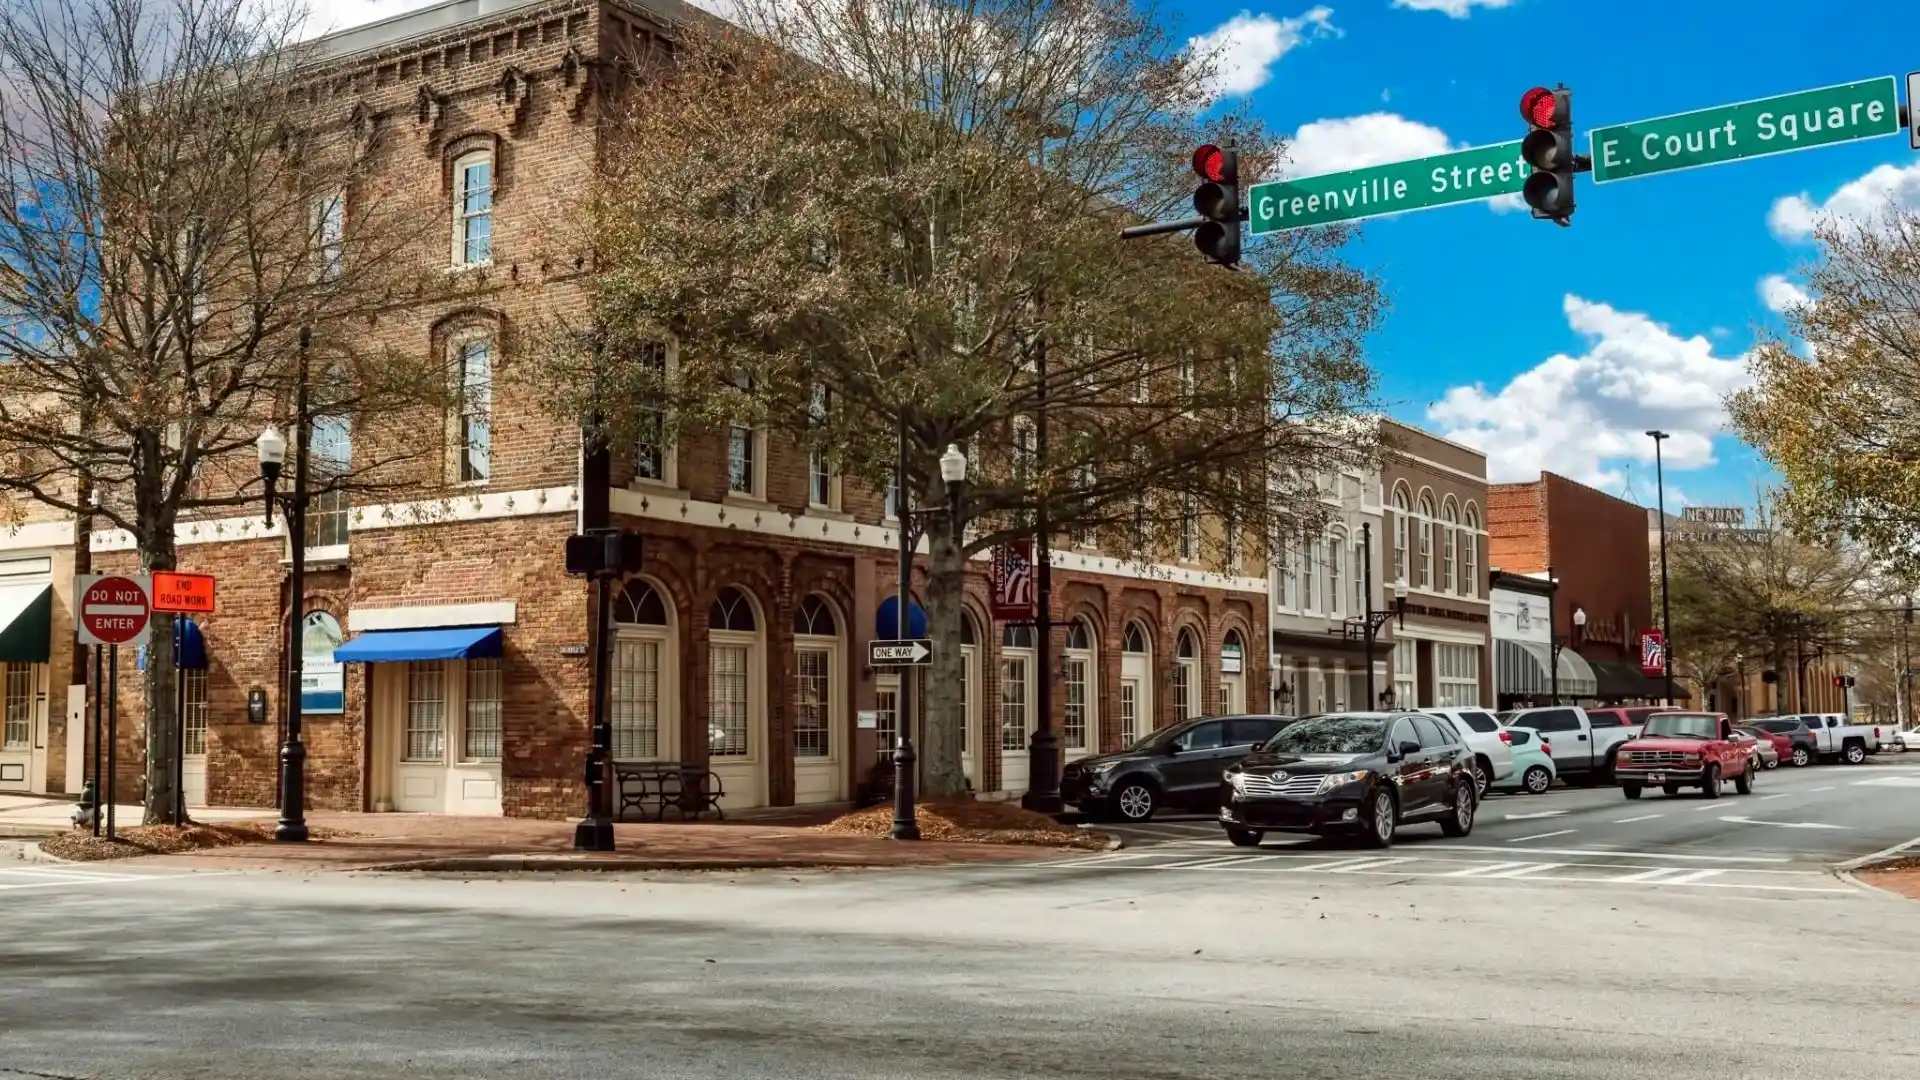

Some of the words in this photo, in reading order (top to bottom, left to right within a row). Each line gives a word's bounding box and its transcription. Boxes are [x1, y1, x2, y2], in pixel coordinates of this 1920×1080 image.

[1602, 139, 1631, 168] E.
[1641, 119, 1737, 161] Court
[1756, 99, 1885, 141] Square
[1258, 176, 1408, 221] Greenville
[1431, 154, 1528, 193] Street
[1685, 507, 1744, 521] NEWNAN
[176, 580, 192, 591] END
[91, 590, 108, 601] DO
[115, 590, 140, 602] NOT
[160, 594, 182, 605] ROAD
[185, 595, 207, 606] WORK
[95, 618, 135, 630] ENTER
[875, 647, 893, 658] ONE
[895, 647, 913, 657] WAY
